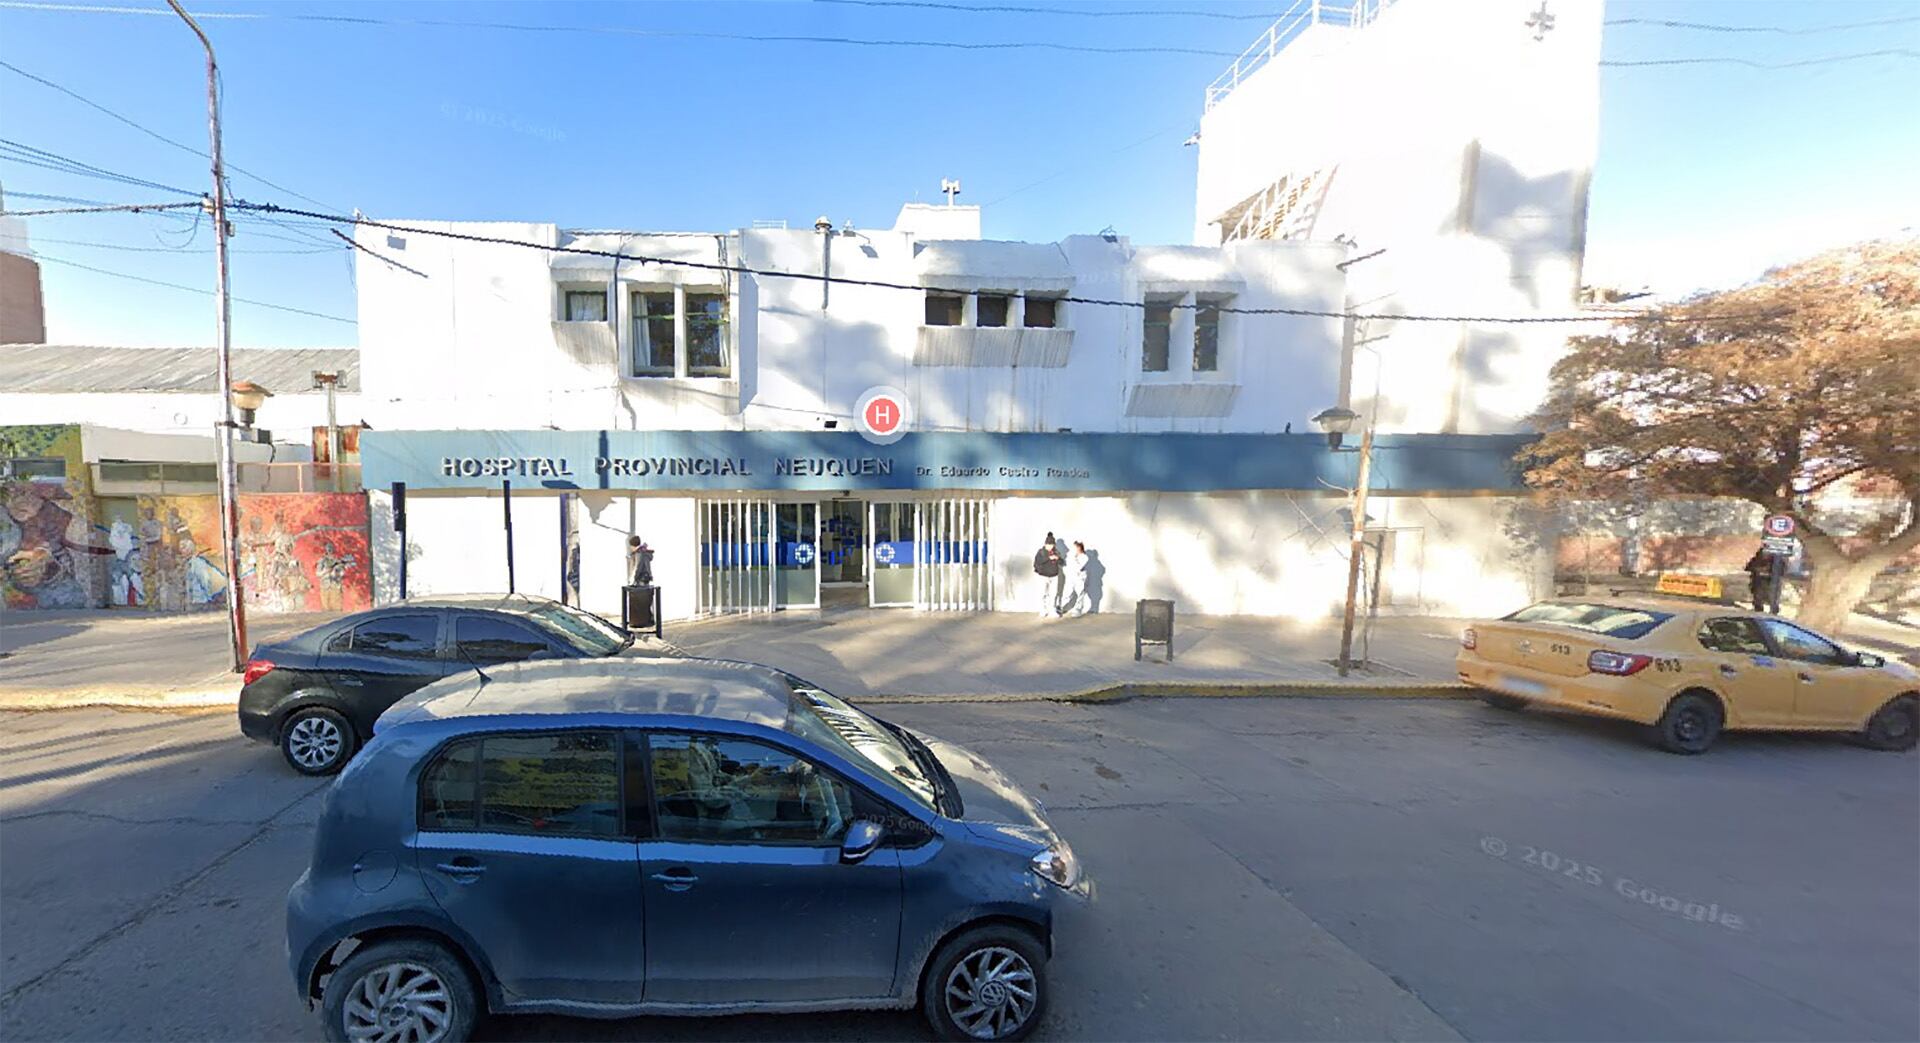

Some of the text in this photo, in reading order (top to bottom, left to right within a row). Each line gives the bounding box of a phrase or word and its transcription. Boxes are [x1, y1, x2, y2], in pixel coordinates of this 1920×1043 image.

[441, 457, 573, 477] HOSPITAL
[595, 457, 753, 477] PROVINCIAL
[774, 457, 894, 477] NEUQUEN
[916, 466, 933, 477] Dr.
[941, 466, 991, 477] Eduardo
